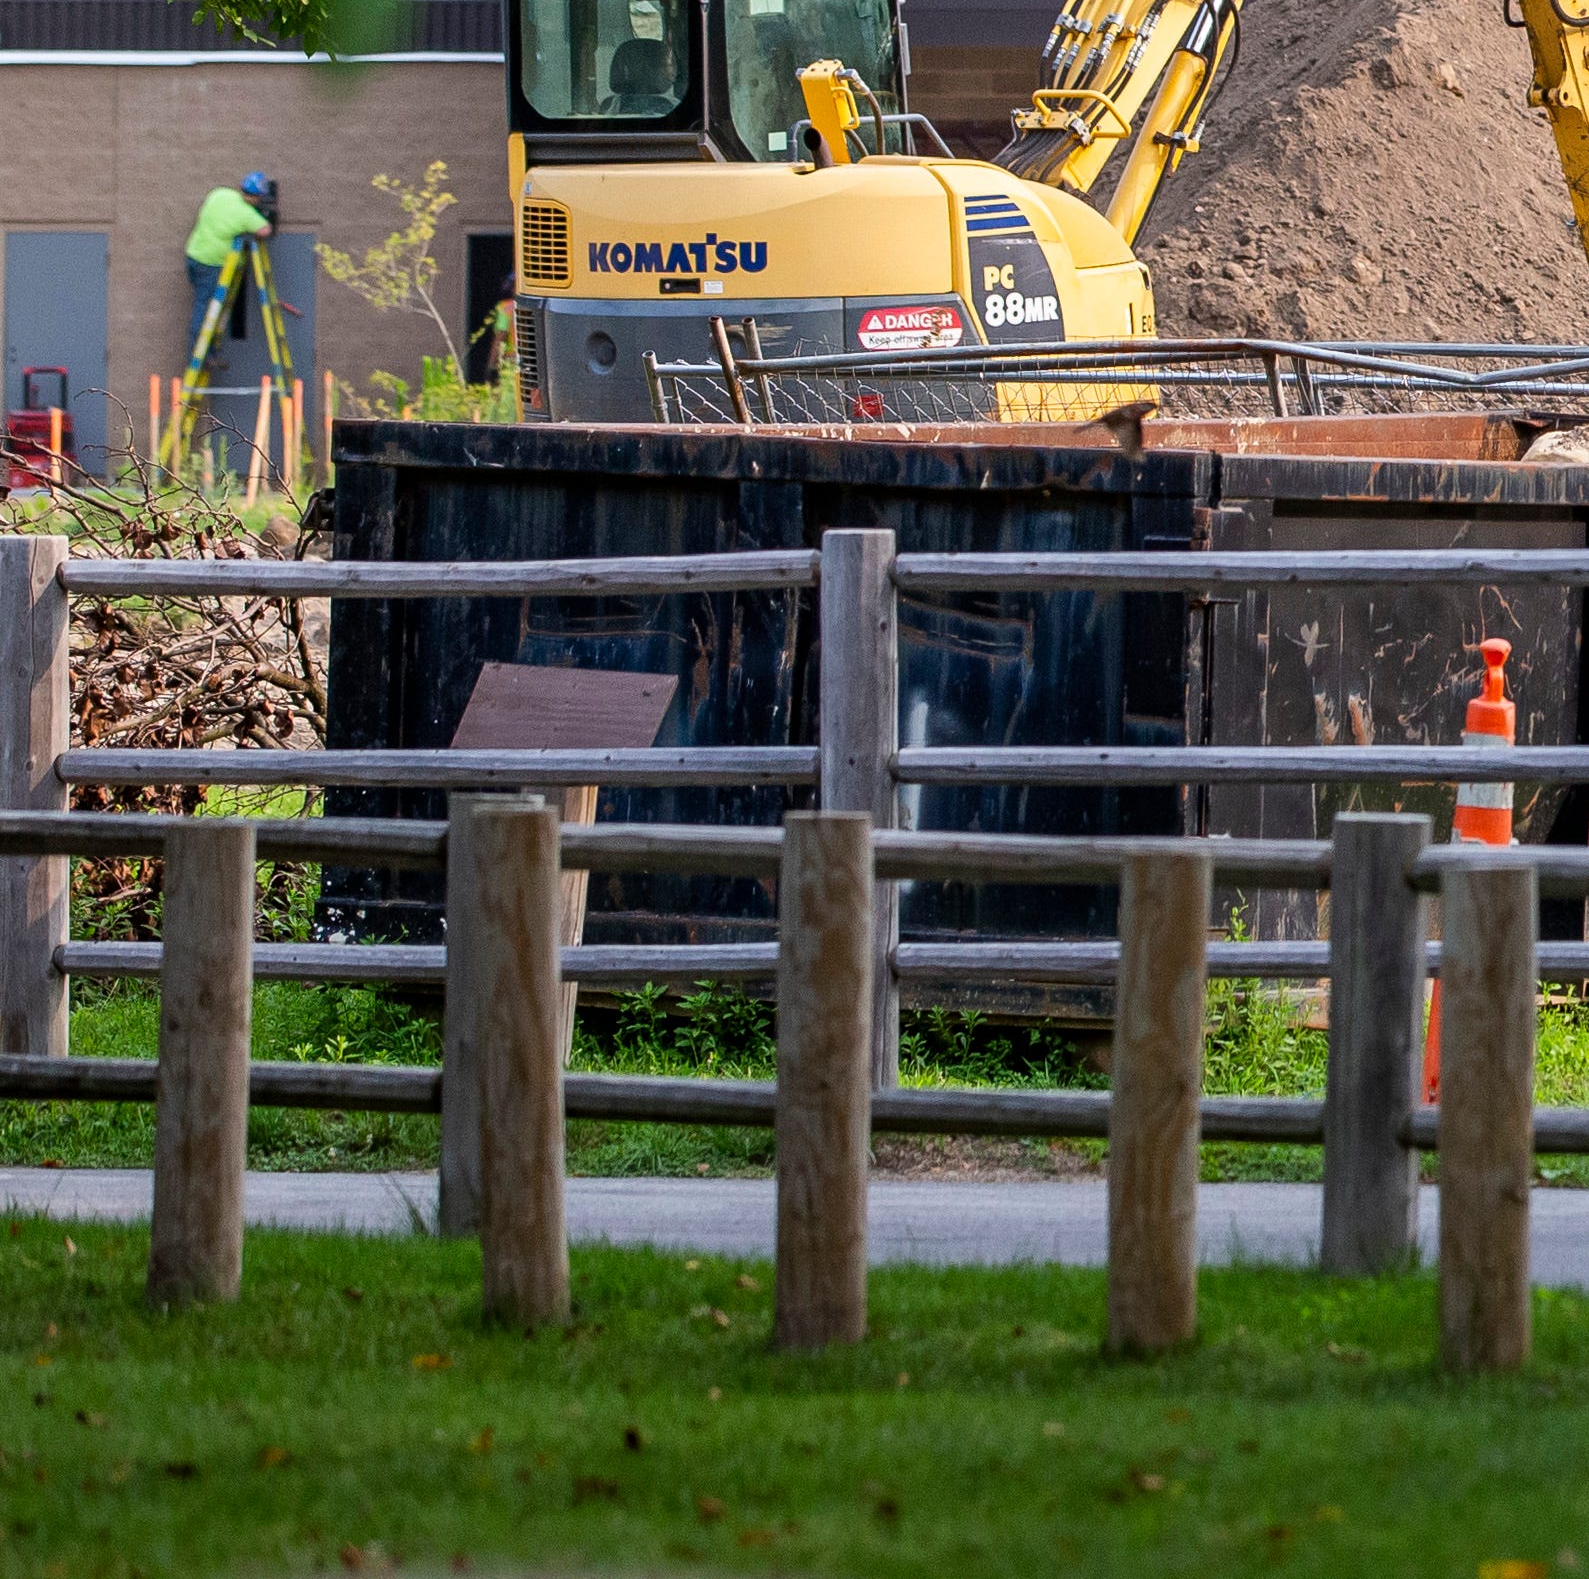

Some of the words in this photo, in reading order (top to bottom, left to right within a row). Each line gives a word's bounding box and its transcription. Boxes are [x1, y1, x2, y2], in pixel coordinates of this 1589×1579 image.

[588, 233, 768, 273] KOMATSU
[983, 264, 1015, 291] PC
[985, 292, 1059, 327] 88MR
